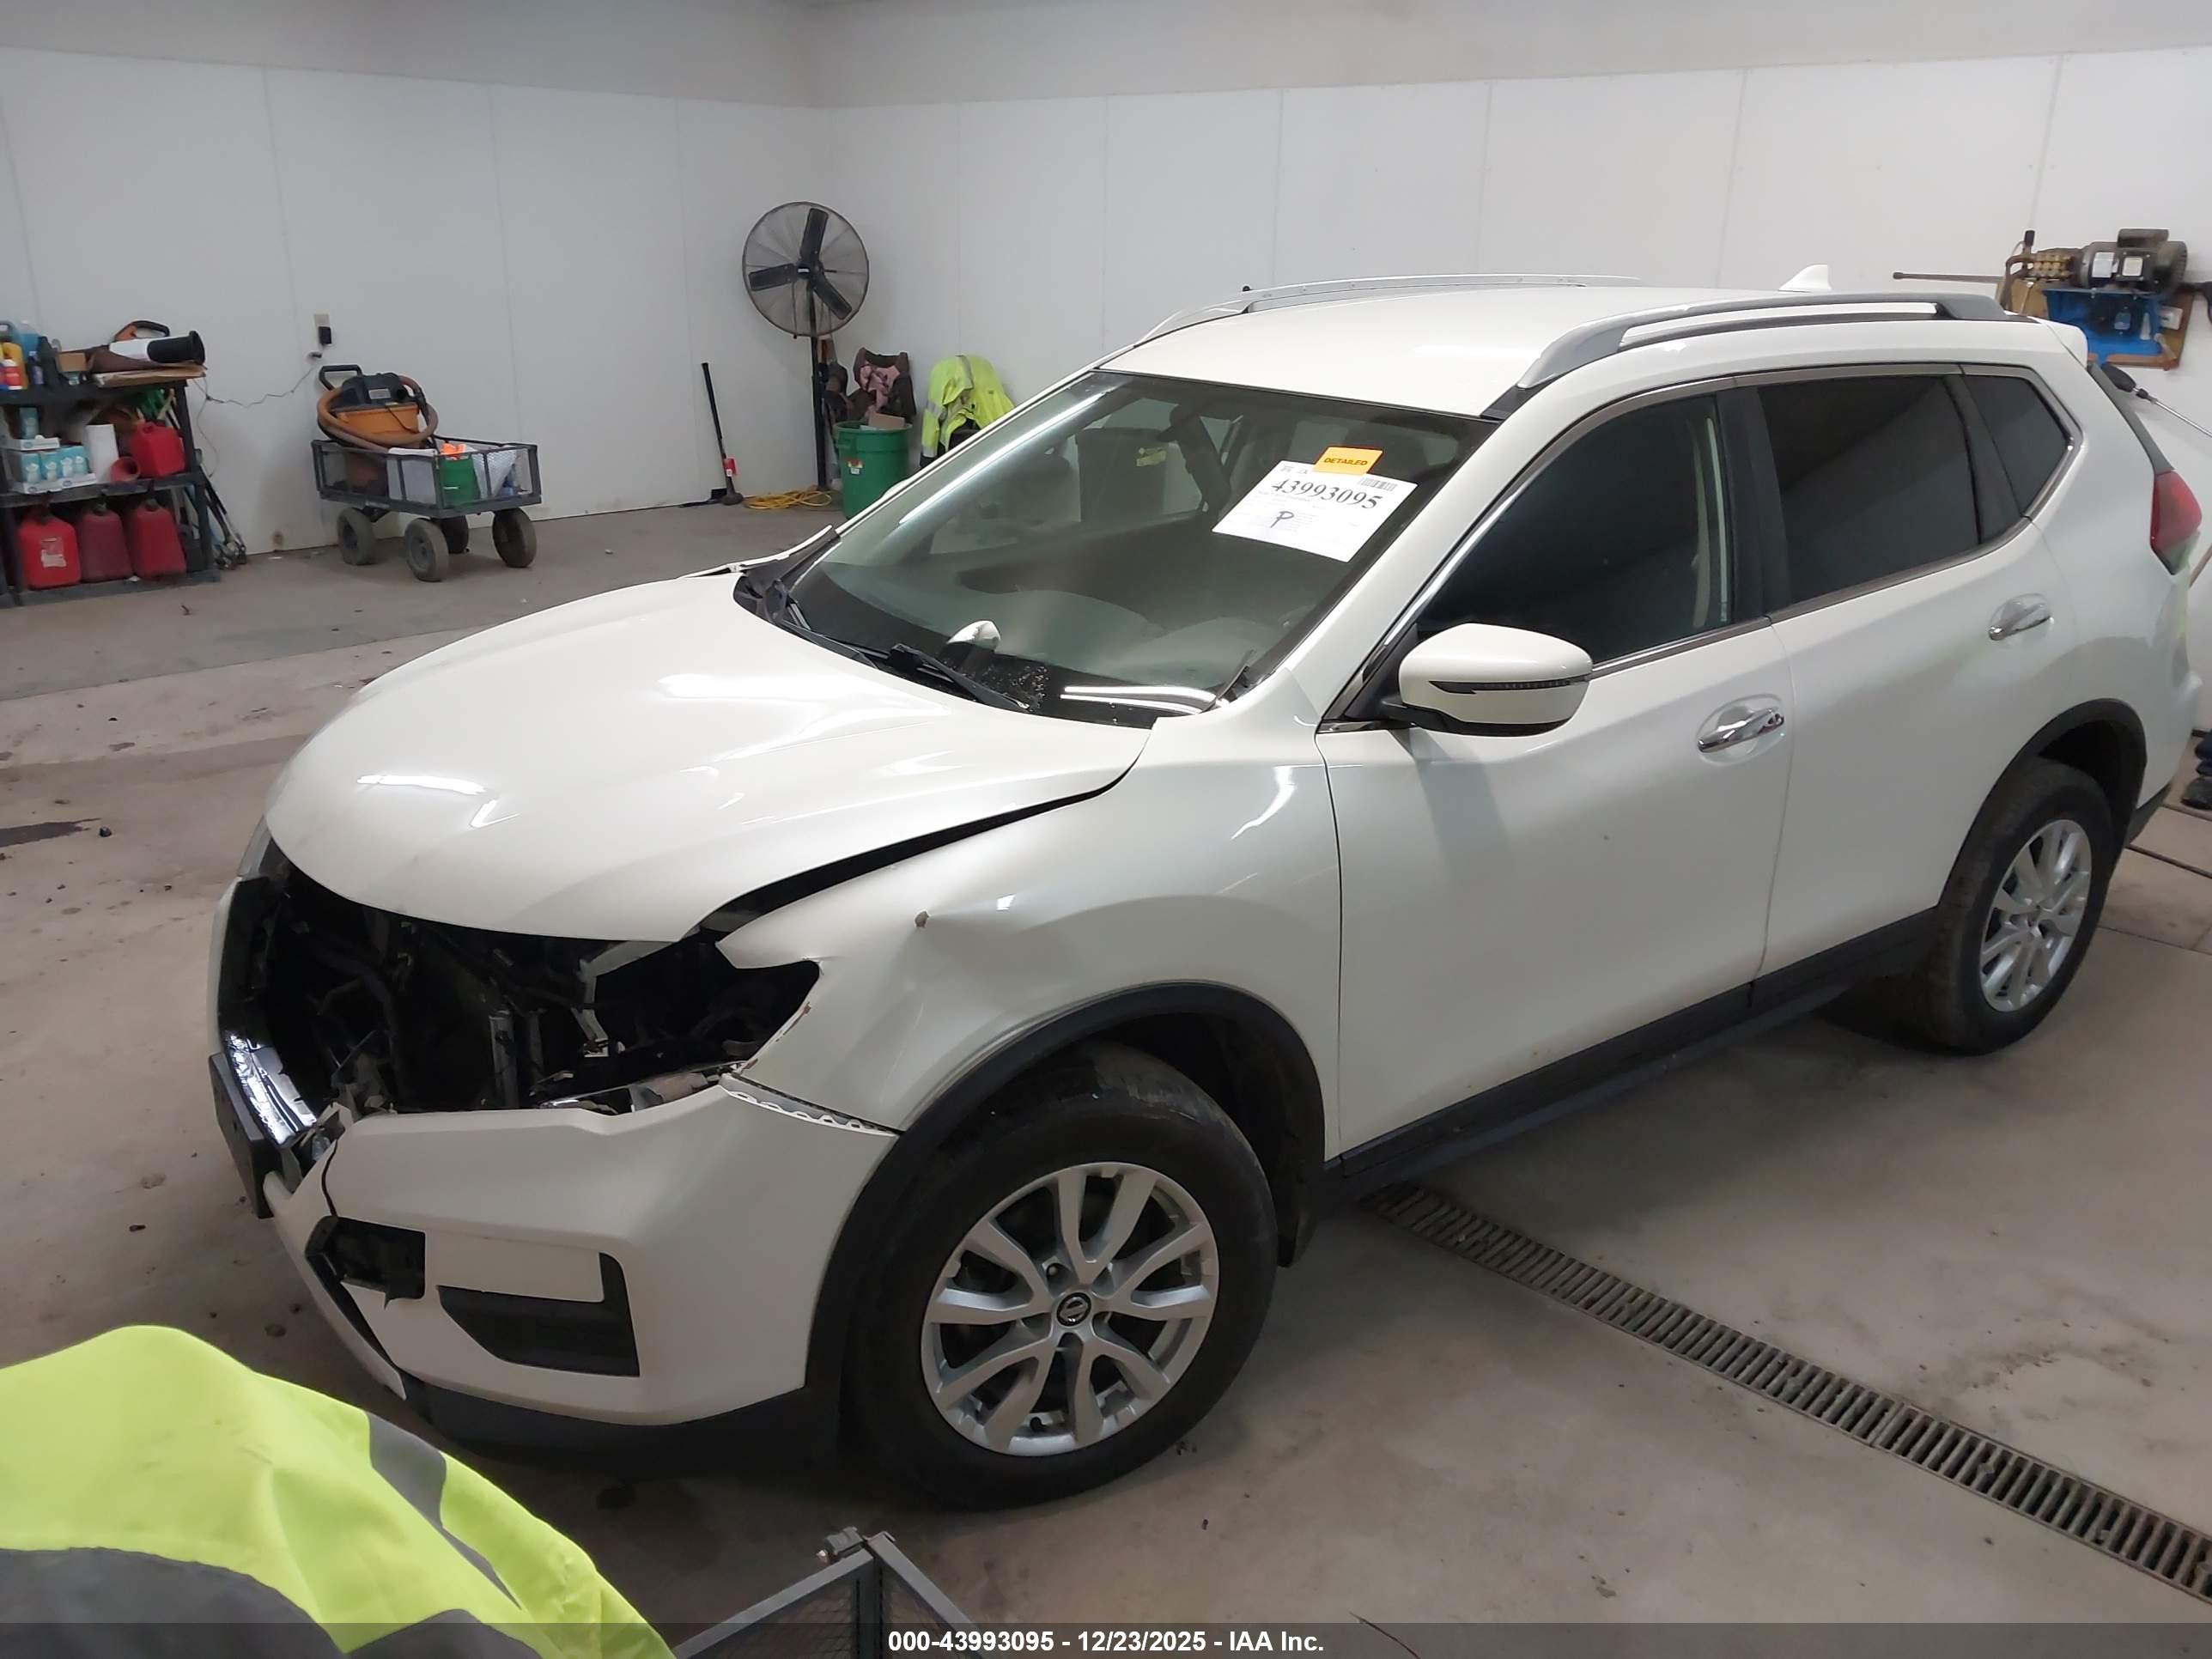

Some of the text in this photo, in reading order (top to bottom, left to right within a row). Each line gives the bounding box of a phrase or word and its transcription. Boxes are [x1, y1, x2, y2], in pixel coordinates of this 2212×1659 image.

[1323, 457, 1368, 466] DETAILED
[1271, 477, 1384, 509] 43993095
[1270, 510, 1295, 528] P
